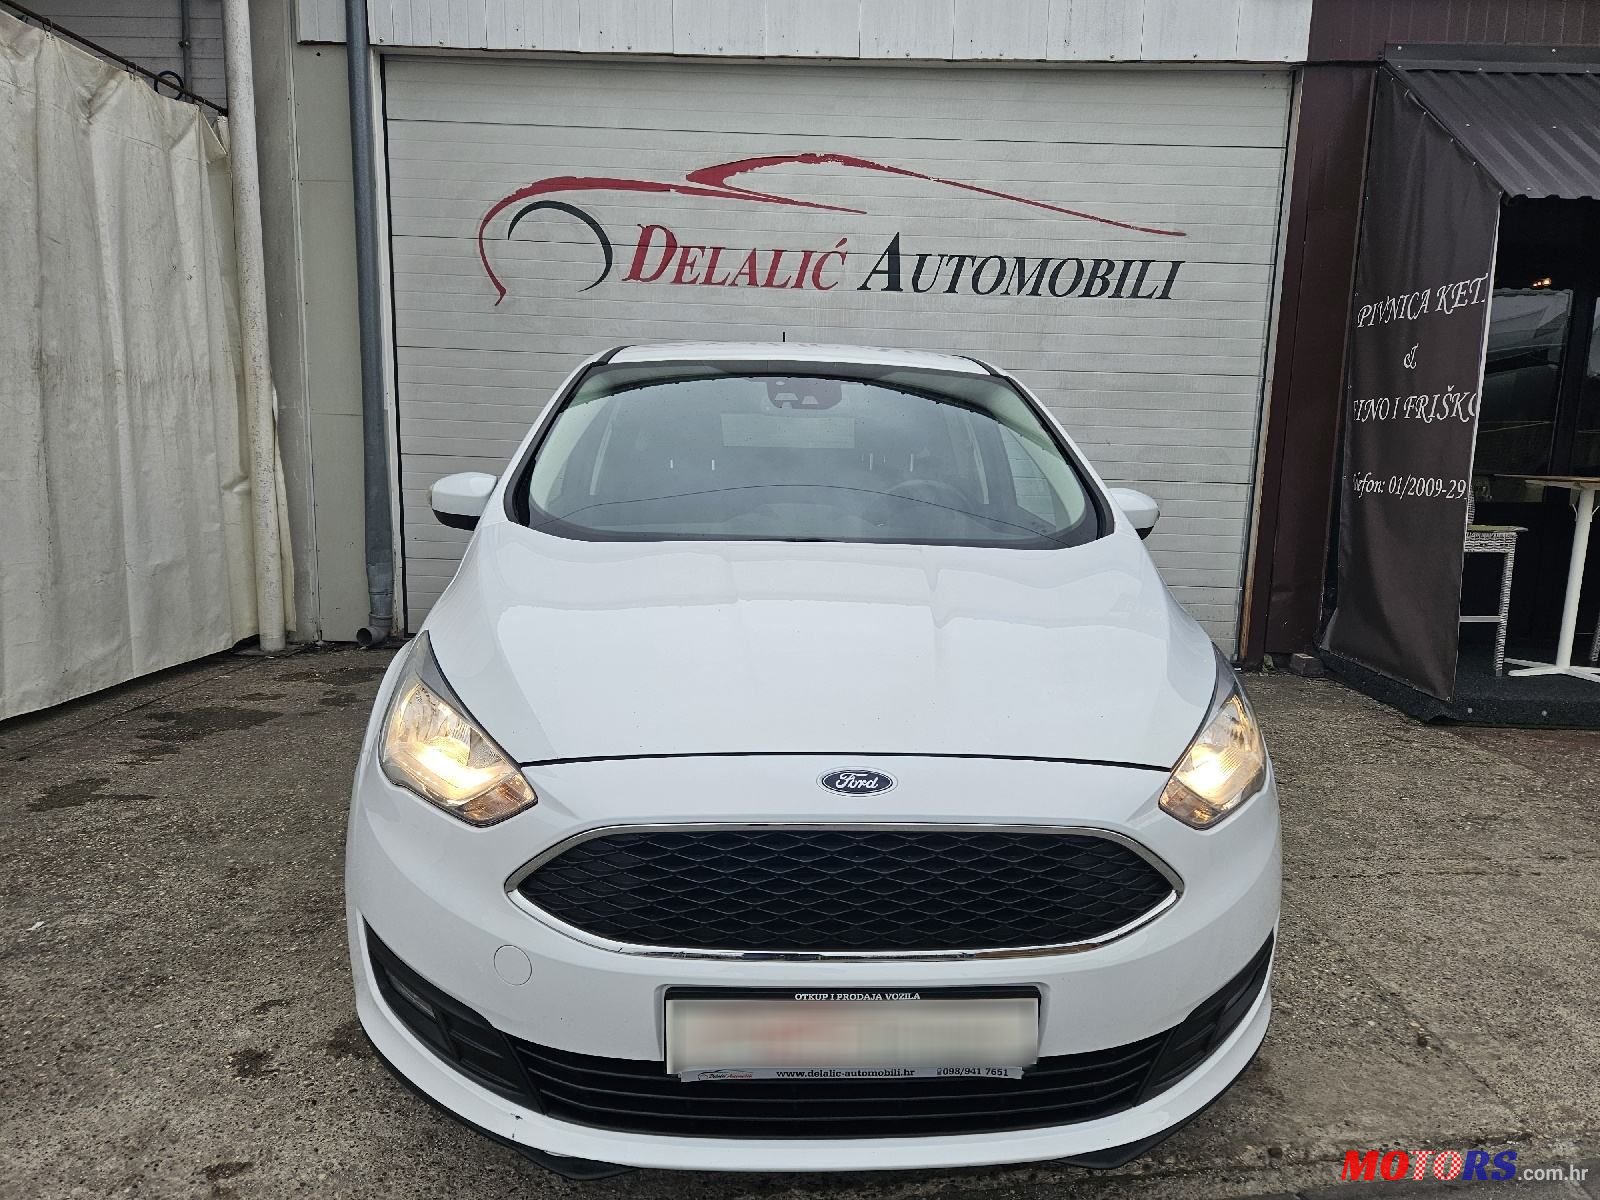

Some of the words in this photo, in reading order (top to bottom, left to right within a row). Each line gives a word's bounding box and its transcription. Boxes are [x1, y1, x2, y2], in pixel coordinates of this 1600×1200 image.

[622, 223, 848, 291] DELALIĆ
[857, 231, 1186, 300] AUTOMOBILI
[1357, 288, 1431, 328] PIVNICA
[1403, 342, 1419, 369] &
[1391, 396, 1401, 419] I
[835, 772, 878, 788] Ford
[794, 993, 828, 1001] OTKUP
[836, 993, 883, 1001] PRODAJA
[885, 992, 921, 1000] VOZILA
[776, 1068, 916, 1078] www.delalic-automobili.hr
